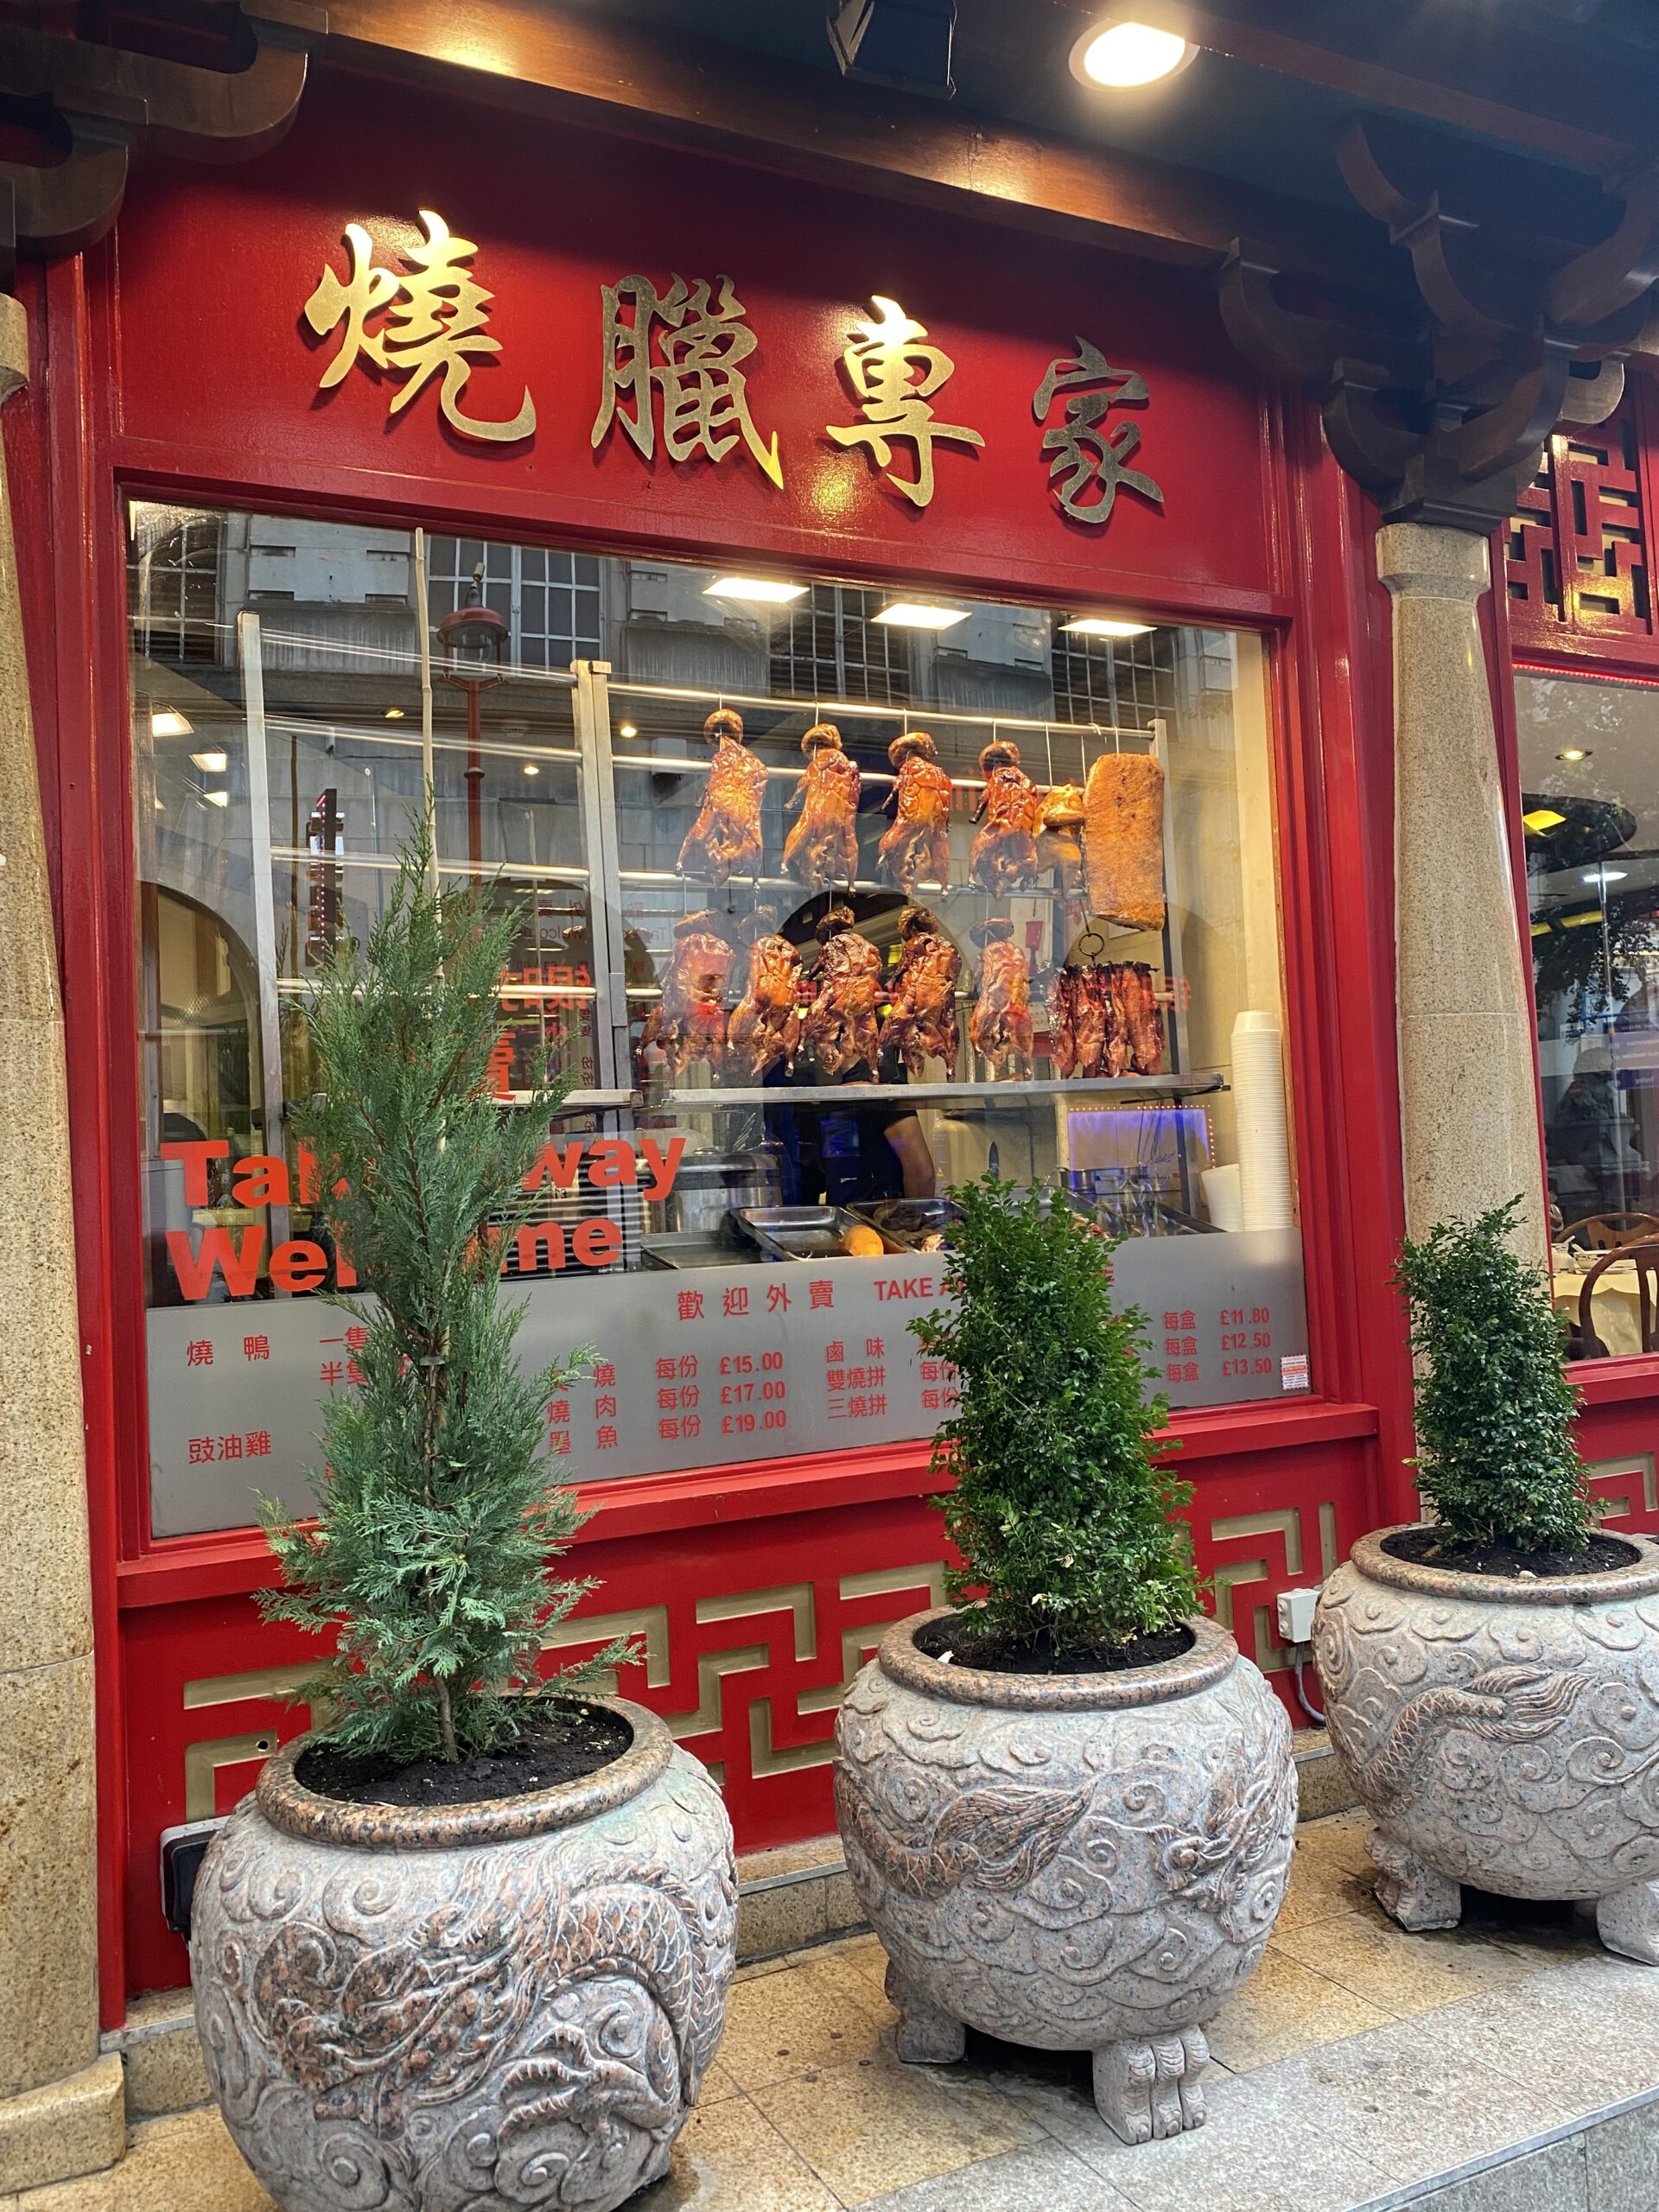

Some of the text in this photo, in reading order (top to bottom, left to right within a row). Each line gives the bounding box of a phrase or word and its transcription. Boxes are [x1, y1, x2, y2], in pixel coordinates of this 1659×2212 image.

[677, 1280, 834, 1321] 歡迎外賣
[874, 1277, 934, 1300] TAKE
[1164, 1307, 1270, 1331] 每盒 £11.80
[187, 1334, 270, 1367] 燒鴨
[1165, 1335, 1198, 1357] 每盒
[656, 1355, 698, 1380] 每份
[719, 1351, 784, 1376] £15.00
[826, 1364, 886, 1392] 雙燒拼
[1166, 1361, 1199, 1382] 每盒
[1223, 1357, 1273, 1377] £13.50
[547, 1380, 785, 1426] 燒肉 每份 £17.00
[827, 1393, 887, 1420] 三燒拼
[658, 1414, 702, 1440] 每份
[721, 1409, 788, 1434] £19.00
[188, 1431, 271, 1465] 豉油雞
